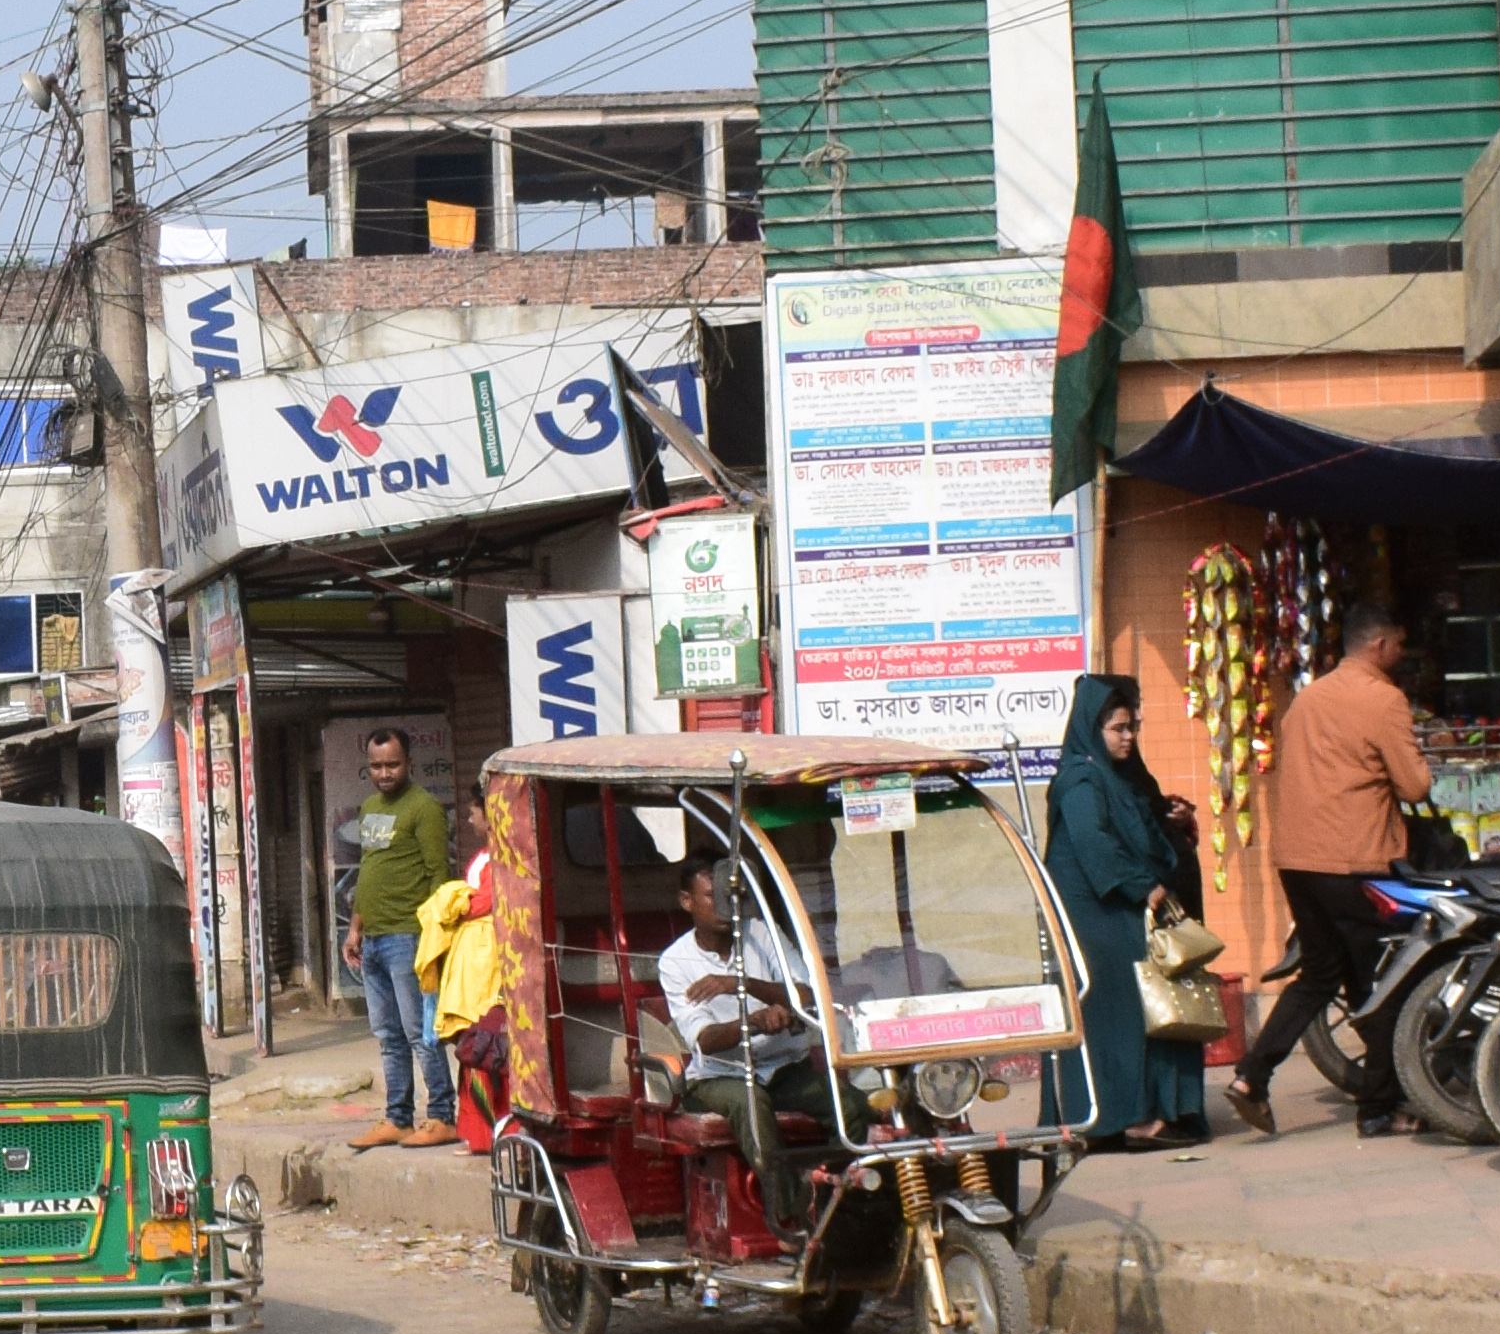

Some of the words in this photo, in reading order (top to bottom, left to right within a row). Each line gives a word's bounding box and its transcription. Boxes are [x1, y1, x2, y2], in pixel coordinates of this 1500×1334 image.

[822, 300, 863, 318] Digital
[866, 299, 901, 314] Saba
[904, 295, 957, 315] Hospital
[186, 284, 241, 397] WA
[475, 378, 502, 473] waltonbd.com
[256, 453, 451, 514] WALTON
[681, 575, 726, 594] নগদ
[536, 620, 598, 740] WA
[817, 698, 848, 720] ডা.
[853, 694, 921, 726] নুসরাত
[930, 692, 989, 718] জাহান
[994, 685, 1067, 720] (নোভা)
